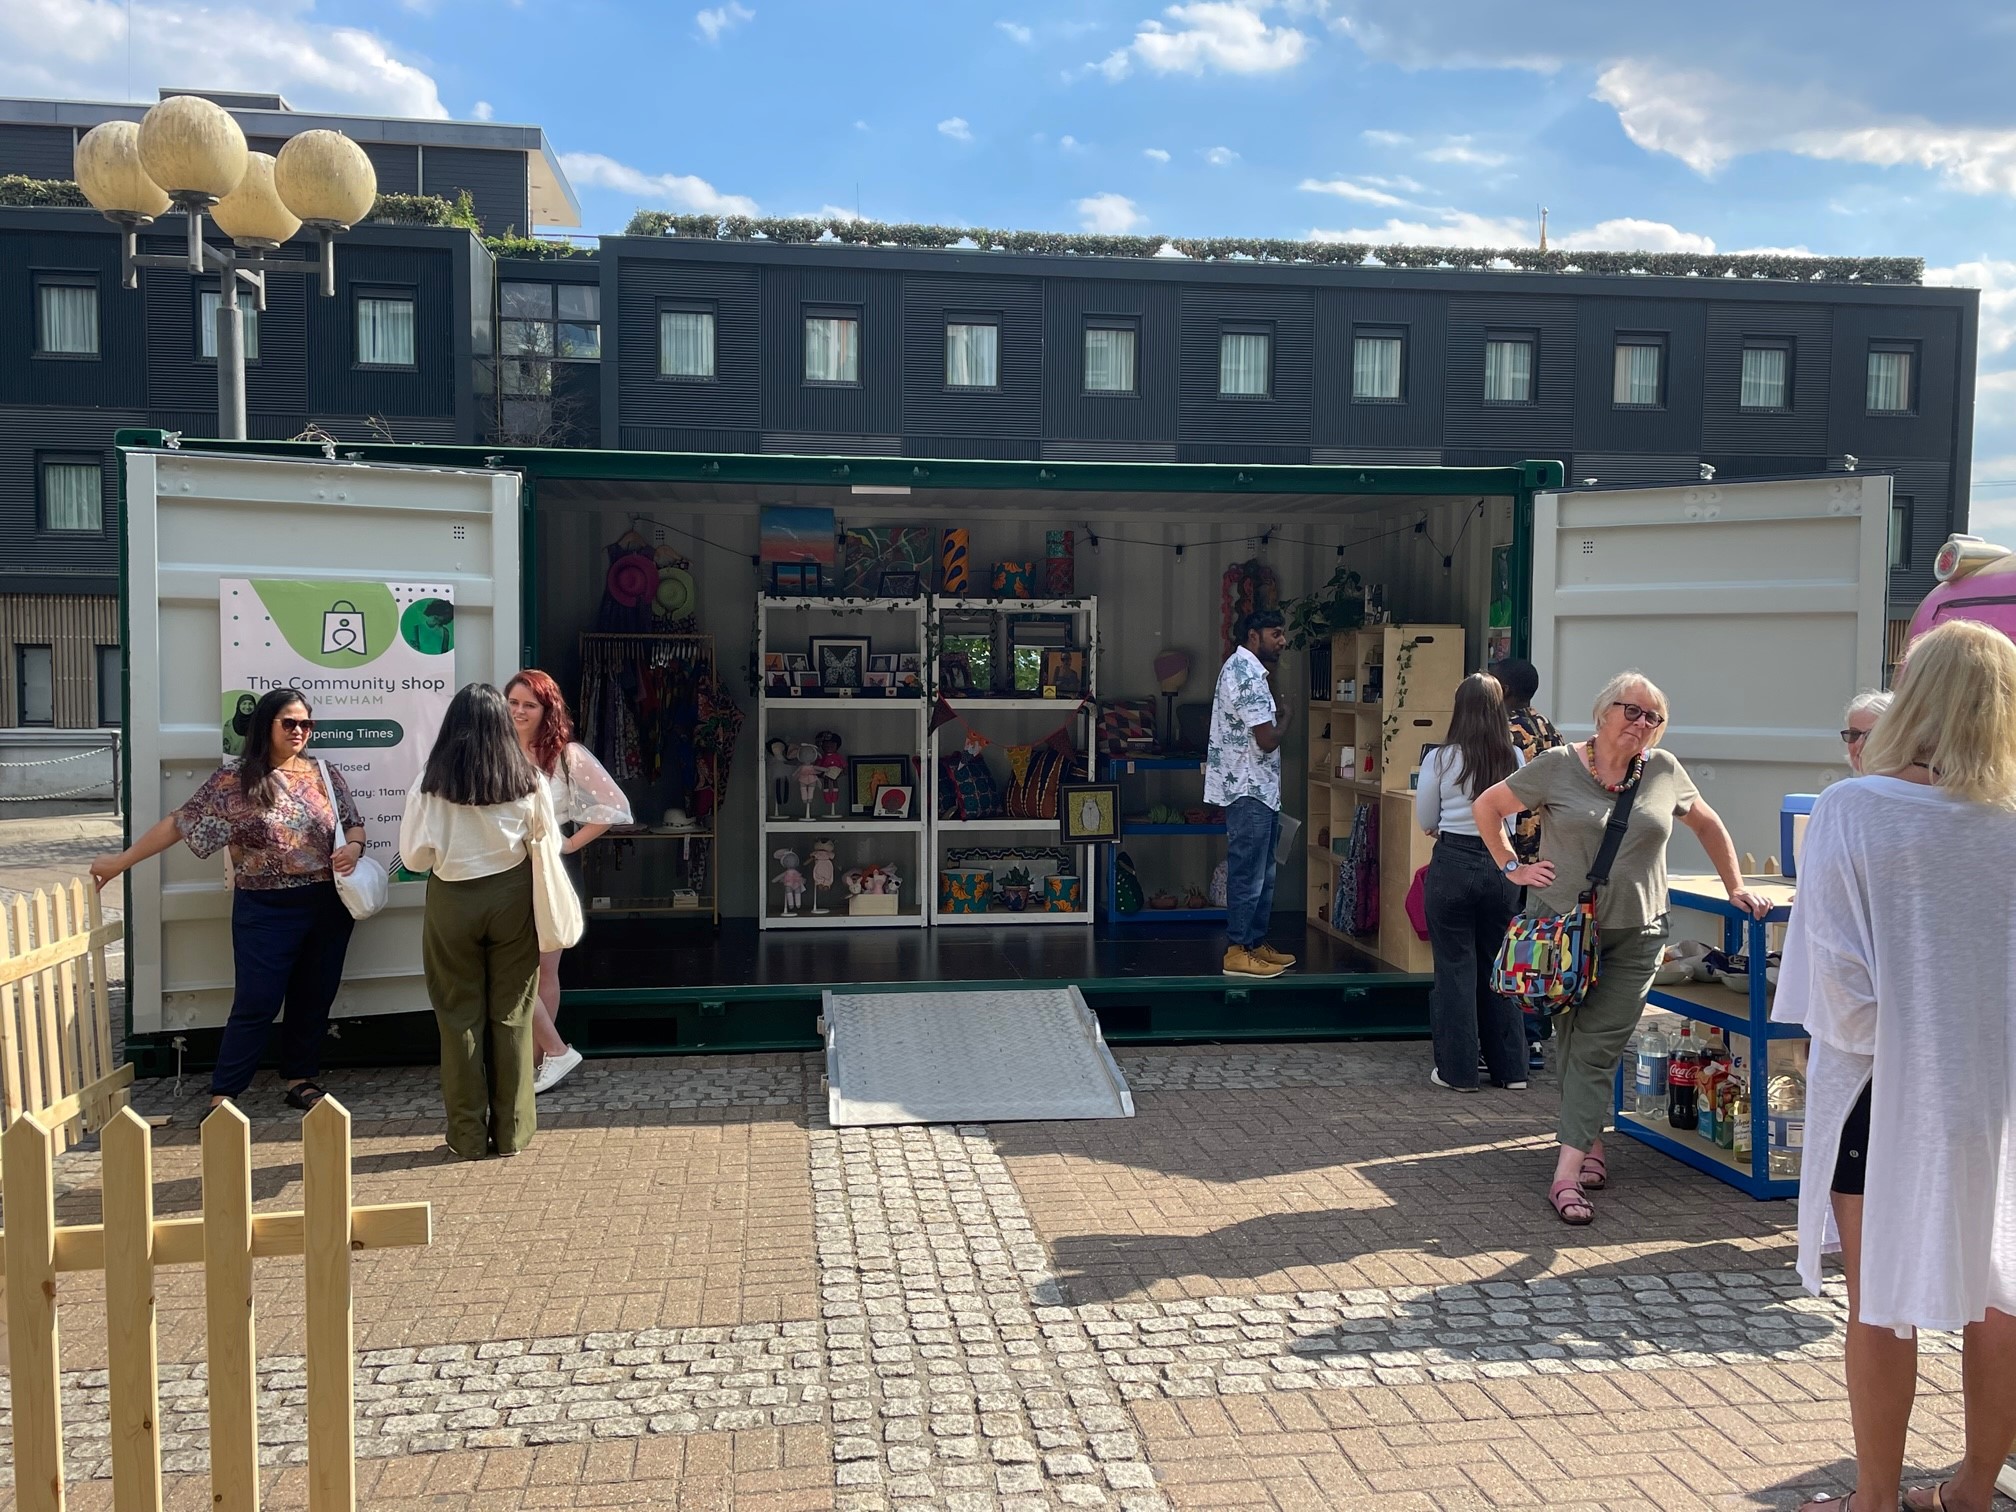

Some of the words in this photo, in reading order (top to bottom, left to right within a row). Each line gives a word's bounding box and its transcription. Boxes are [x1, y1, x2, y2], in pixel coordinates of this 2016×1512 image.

[246, 676, 282, 690] The
[288, 676, 396, 693] Community
[401, 676, 445, 693] shop
[313, 695, 384, 705] NEWHAM
[357, 728, 394, 739] Times
[378, 788, 406, 797] 11am
[377, 813, 402, 824] 6pm
